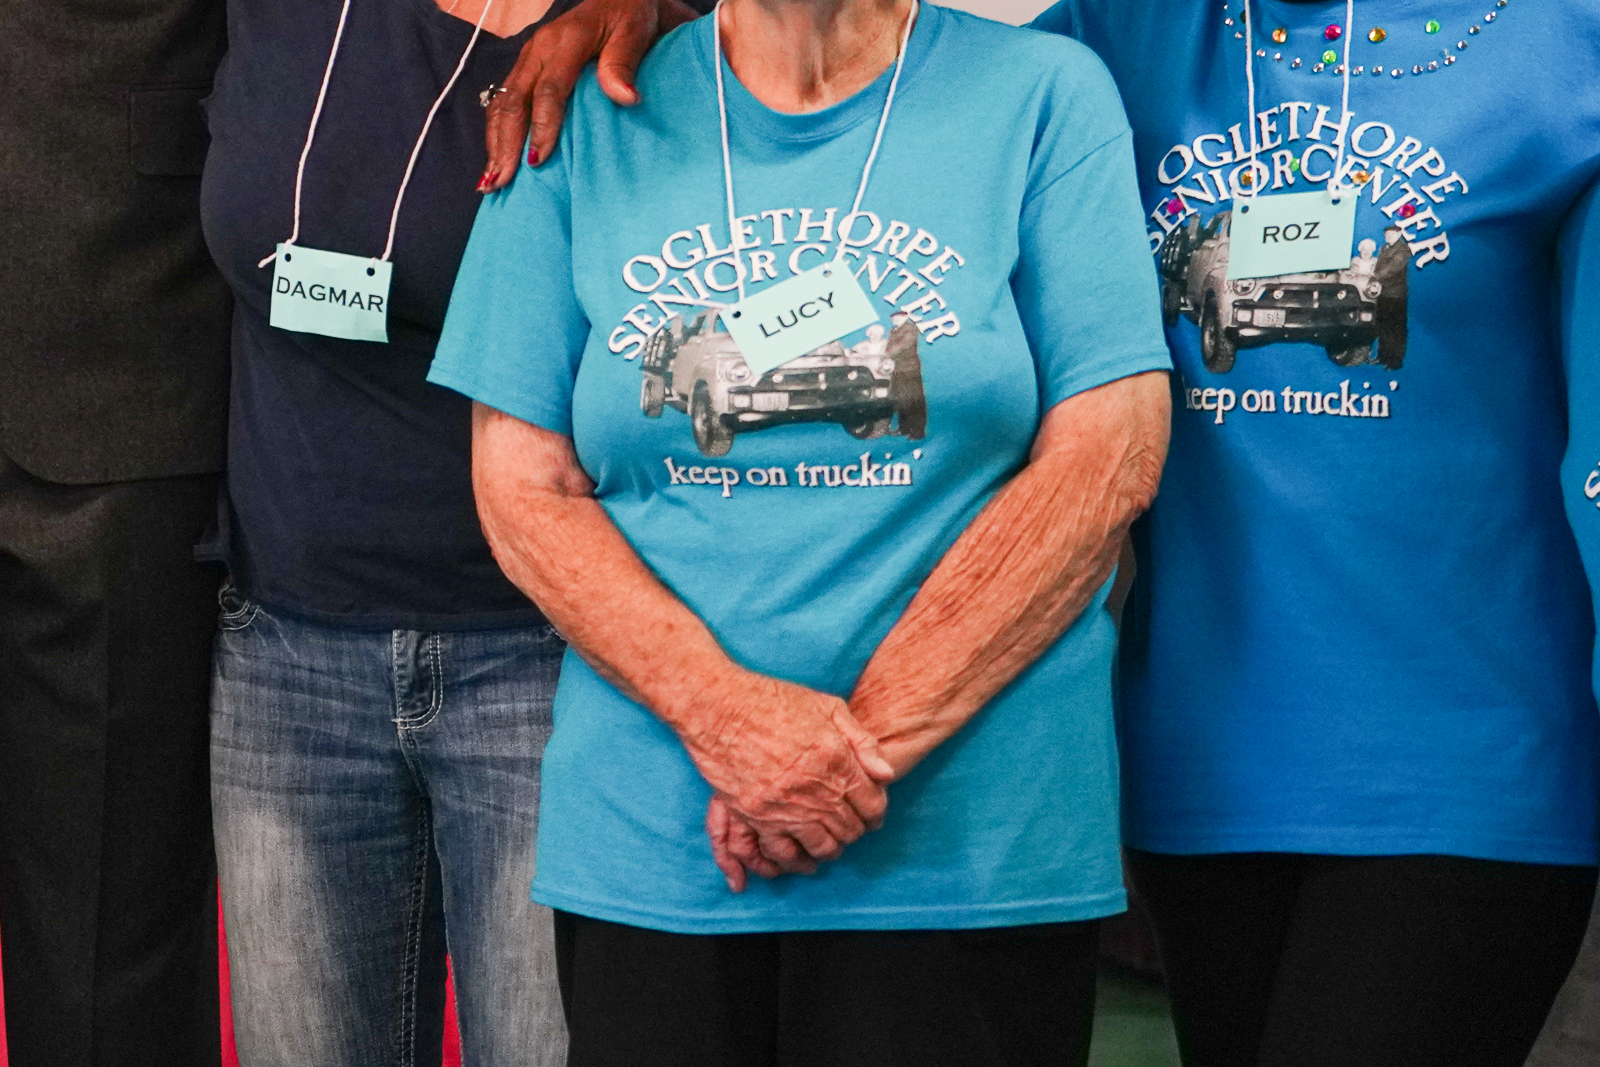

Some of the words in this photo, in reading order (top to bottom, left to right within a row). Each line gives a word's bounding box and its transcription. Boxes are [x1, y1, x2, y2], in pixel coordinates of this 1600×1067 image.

[1157, 101, 1469, 204] OGLETHORPE
[1301, 144, 1450, 269] CENTER
[622, 207, 966, 293] OGLETHORPE
[1262, 221, 1321, 244] ROZ
[276, 275, 384, 313] DAGMAR
[608, 251, 777, 361] SENIOR
[758, 291, 834, 338] LUCY
[1242, 389, 1275, 412] on
[1281, 380, 1398, 418] truckin'
[664, 457, 739, 497] keep
[746, 467, 788, 486] on
[795, 449, 922, 487] truckin'
